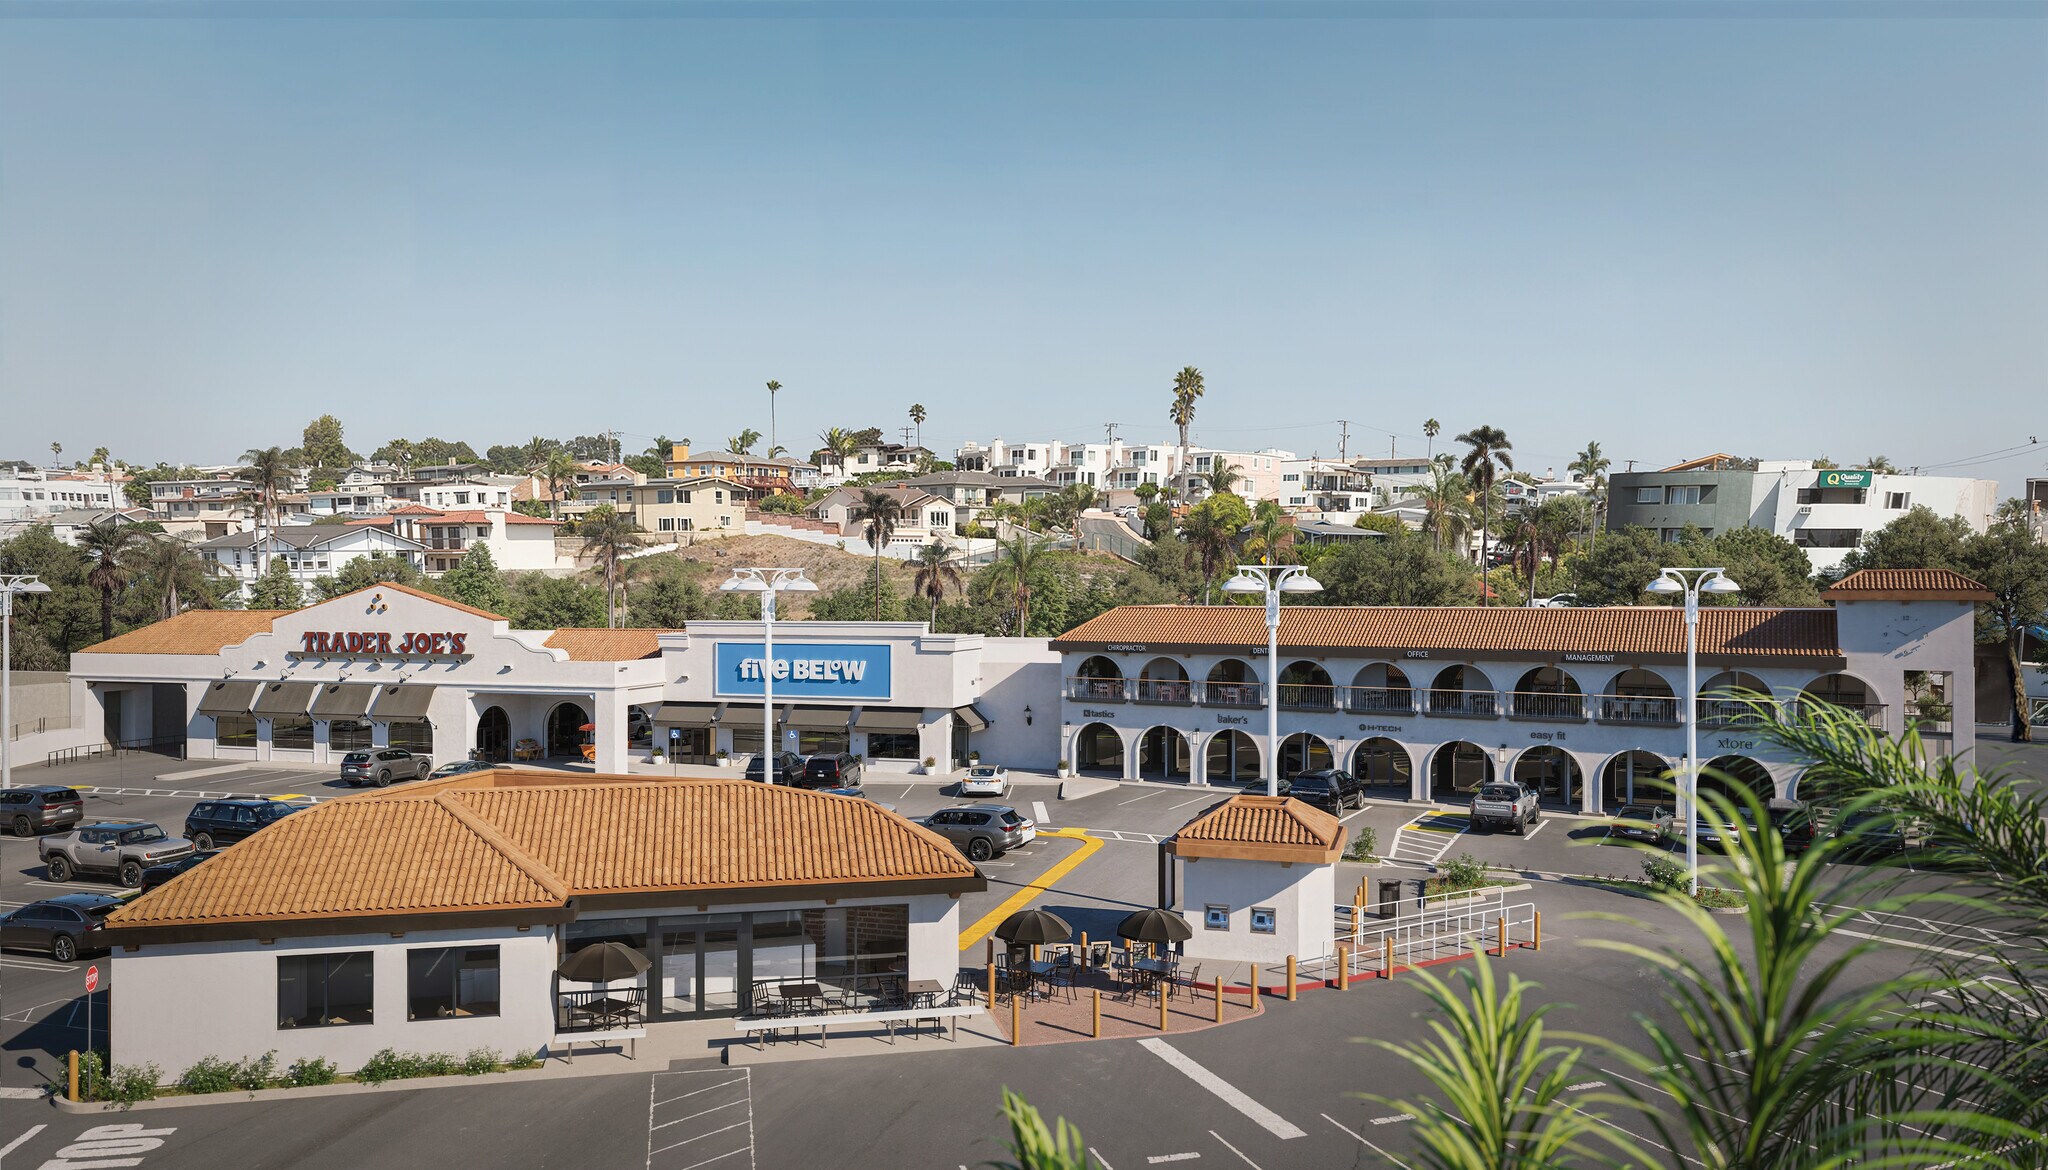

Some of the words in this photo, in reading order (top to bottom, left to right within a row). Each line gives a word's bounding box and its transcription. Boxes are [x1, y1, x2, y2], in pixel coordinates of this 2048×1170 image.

[1840, 473, 1864, 483] Quality
[303, 631, 393, 653] TRADER
[400, 631, 468, 654] JOE'S
[1107, 644, 1147, 652] CHIROPRACTOR
[1406, 650, 1429, 658] OFFICE
[1565, 653, 1615, 662] MANAGEMENT
[1217, 713, 1248, 724] baker's
[1530, 731, 1553, 741] easy
[1556, 731, 1567, 741] fit
